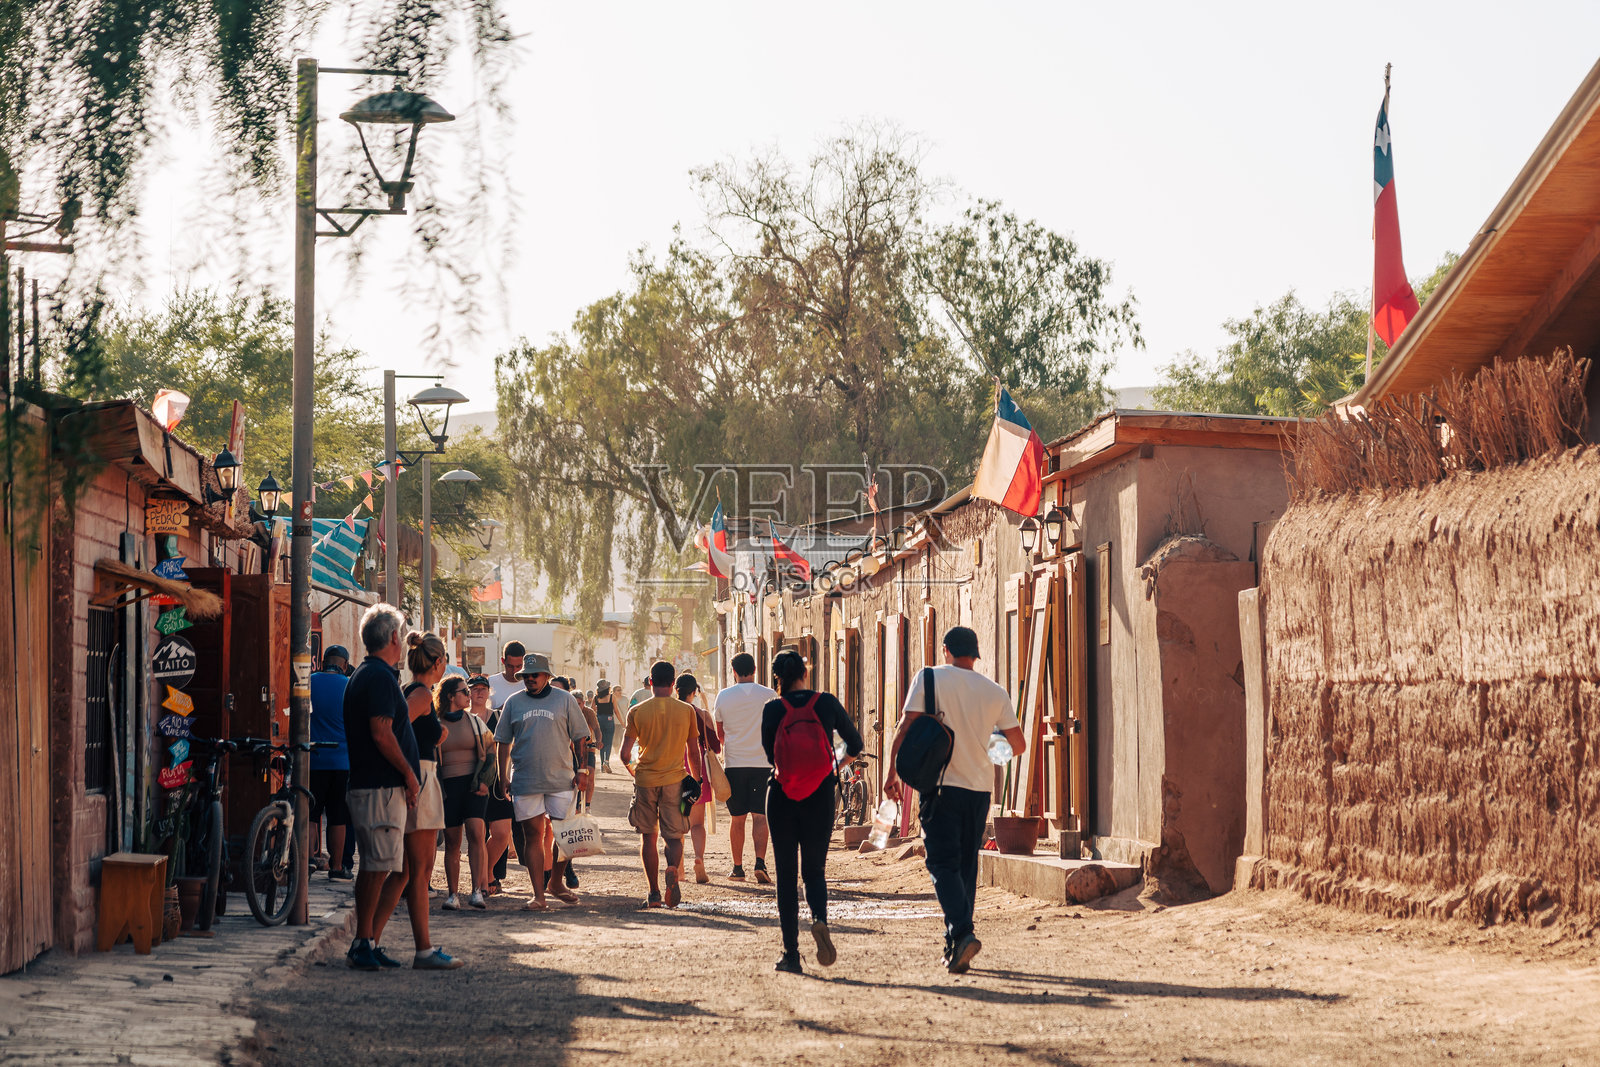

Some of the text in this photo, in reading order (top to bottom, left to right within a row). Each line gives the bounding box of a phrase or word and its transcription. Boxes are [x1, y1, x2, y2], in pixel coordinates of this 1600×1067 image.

[155, 500, 173, 514] SAN
[151, 512, 182, 525] PEDRO
[162, 560, 181, 575] PARIS
[158, 659, 190, 670] TAITO
[532, 709, 555, 721] CLOTHING
[171, 716, 182, 729] RIO
[165, 725, 189, 738] JANEIRO
[560, 828, 594, 839] pense
